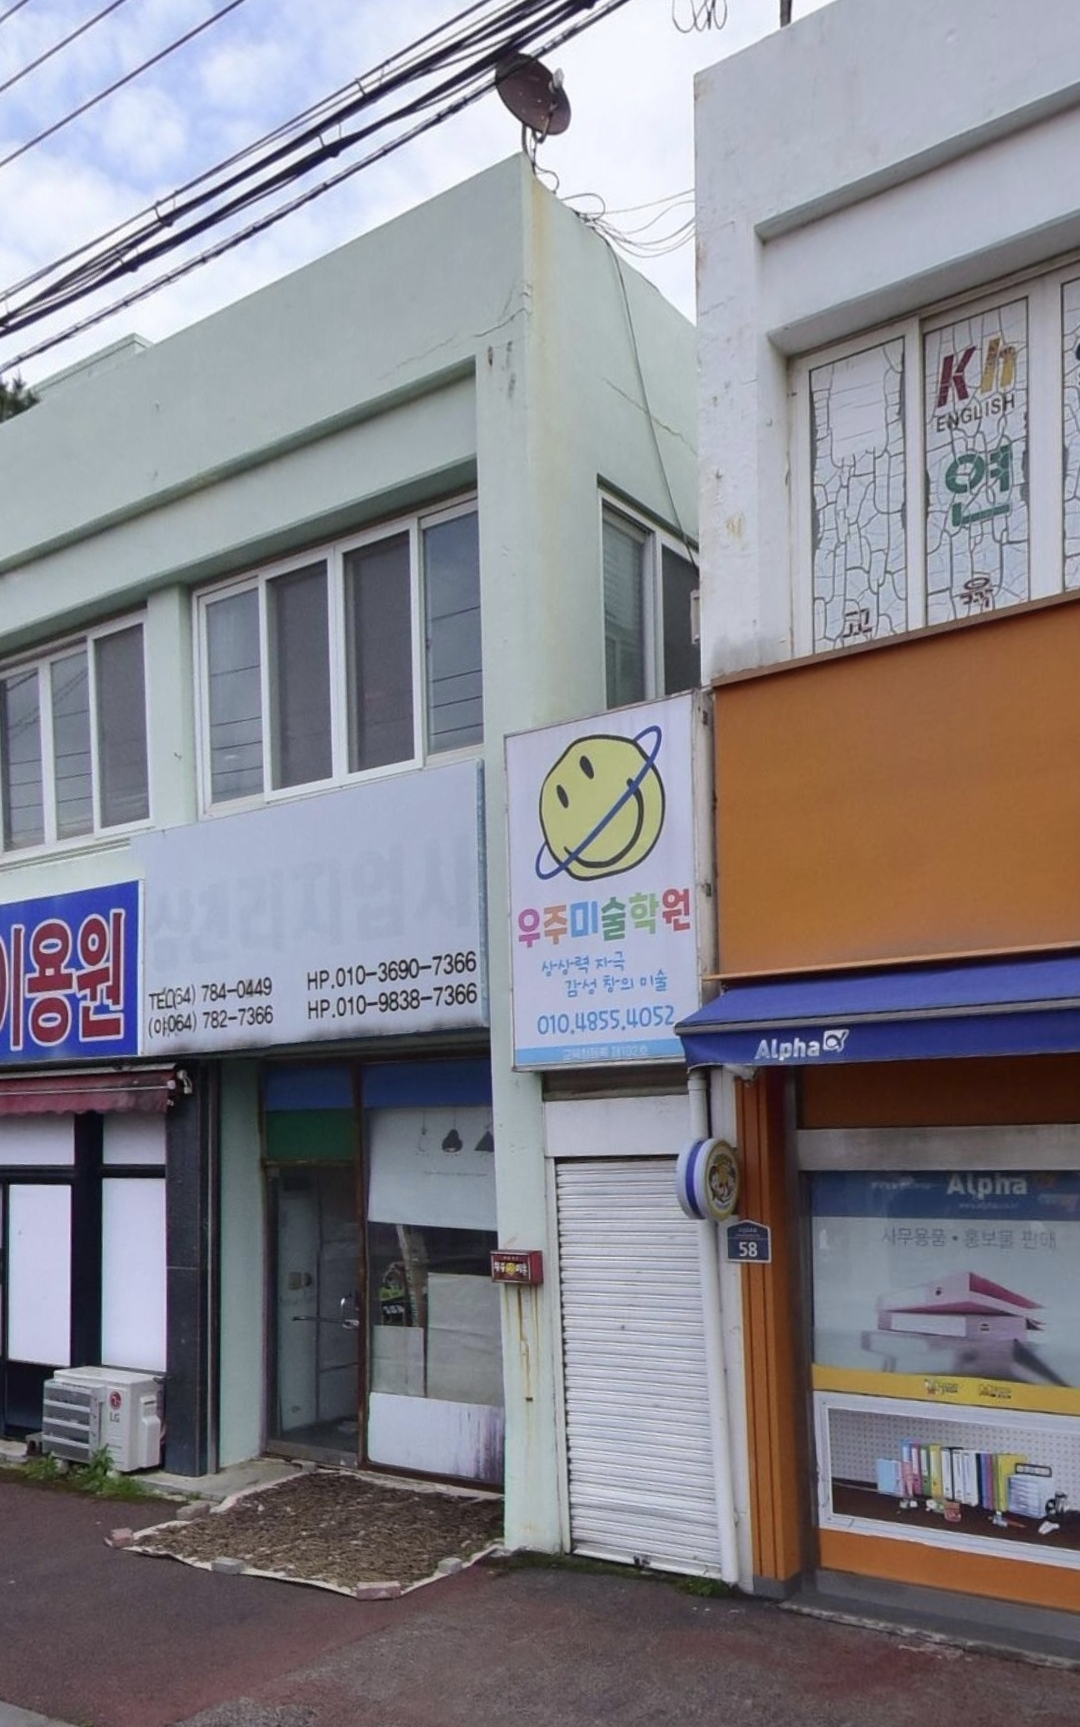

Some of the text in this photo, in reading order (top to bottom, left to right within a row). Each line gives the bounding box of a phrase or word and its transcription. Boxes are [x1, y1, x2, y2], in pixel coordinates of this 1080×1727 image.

[936, 394, 1015, 433] ENGLISH
[945, 445, 1013, 527] 연
[518, 888, 690, 948] 우주미술학원
[541, 951, 626, 977] 상상력 자극
[201, 977, 272, 1002] 784-0449
[565, 968, 668, 998] 감성 창의 미술
[202, 1005, 274, 1029] 782-7366
[537, 1004, 675, 1035] 010.4855.4052
[754, 1037, 820, 1060] Alpha
[946, 1172, 1028, 1200] Alpha
[739, 1241, 758, 1257] 58
[881, 1226, 1057, 1250] 사무용품 홍보물 판매
[110, 1412, 120, 1423] LG
